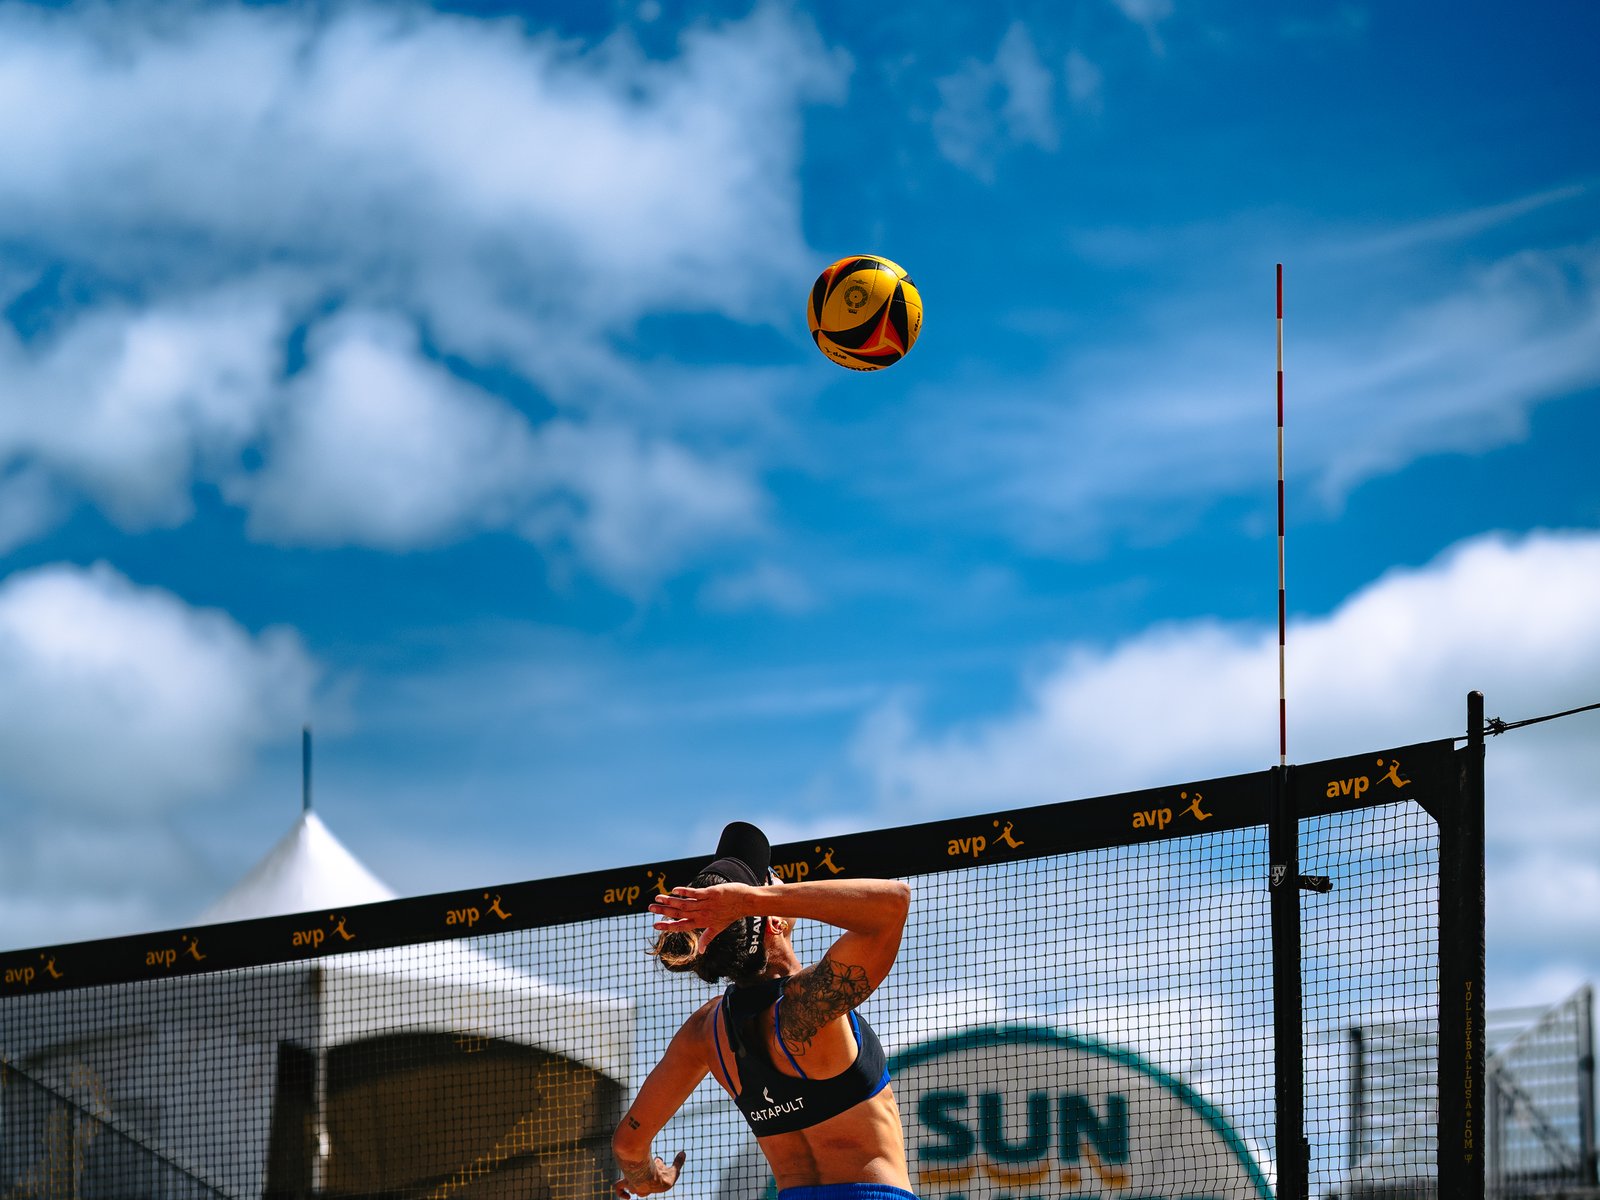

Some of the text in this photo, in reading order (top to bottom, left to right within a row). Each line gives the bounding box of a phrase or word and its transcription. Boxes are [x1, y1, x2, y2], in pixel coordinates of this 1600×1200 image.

[1326, 776, 1371, 799] avp
[1132, 807, 1173, 830] avp
[947, 835, 987, 858] avp
[772, 861, 810, 882] avp
[603, 886, 640, 906] avp
[446, 907, 480, 927] avp
[292, 929, 324, 948] avp
[146, 946, 177, 967] avp
[5, 964, 36, 985] avp
[750, 1097, 804, 1122] CATAPULT
[917, 1091, 1129, 1164] SUN
